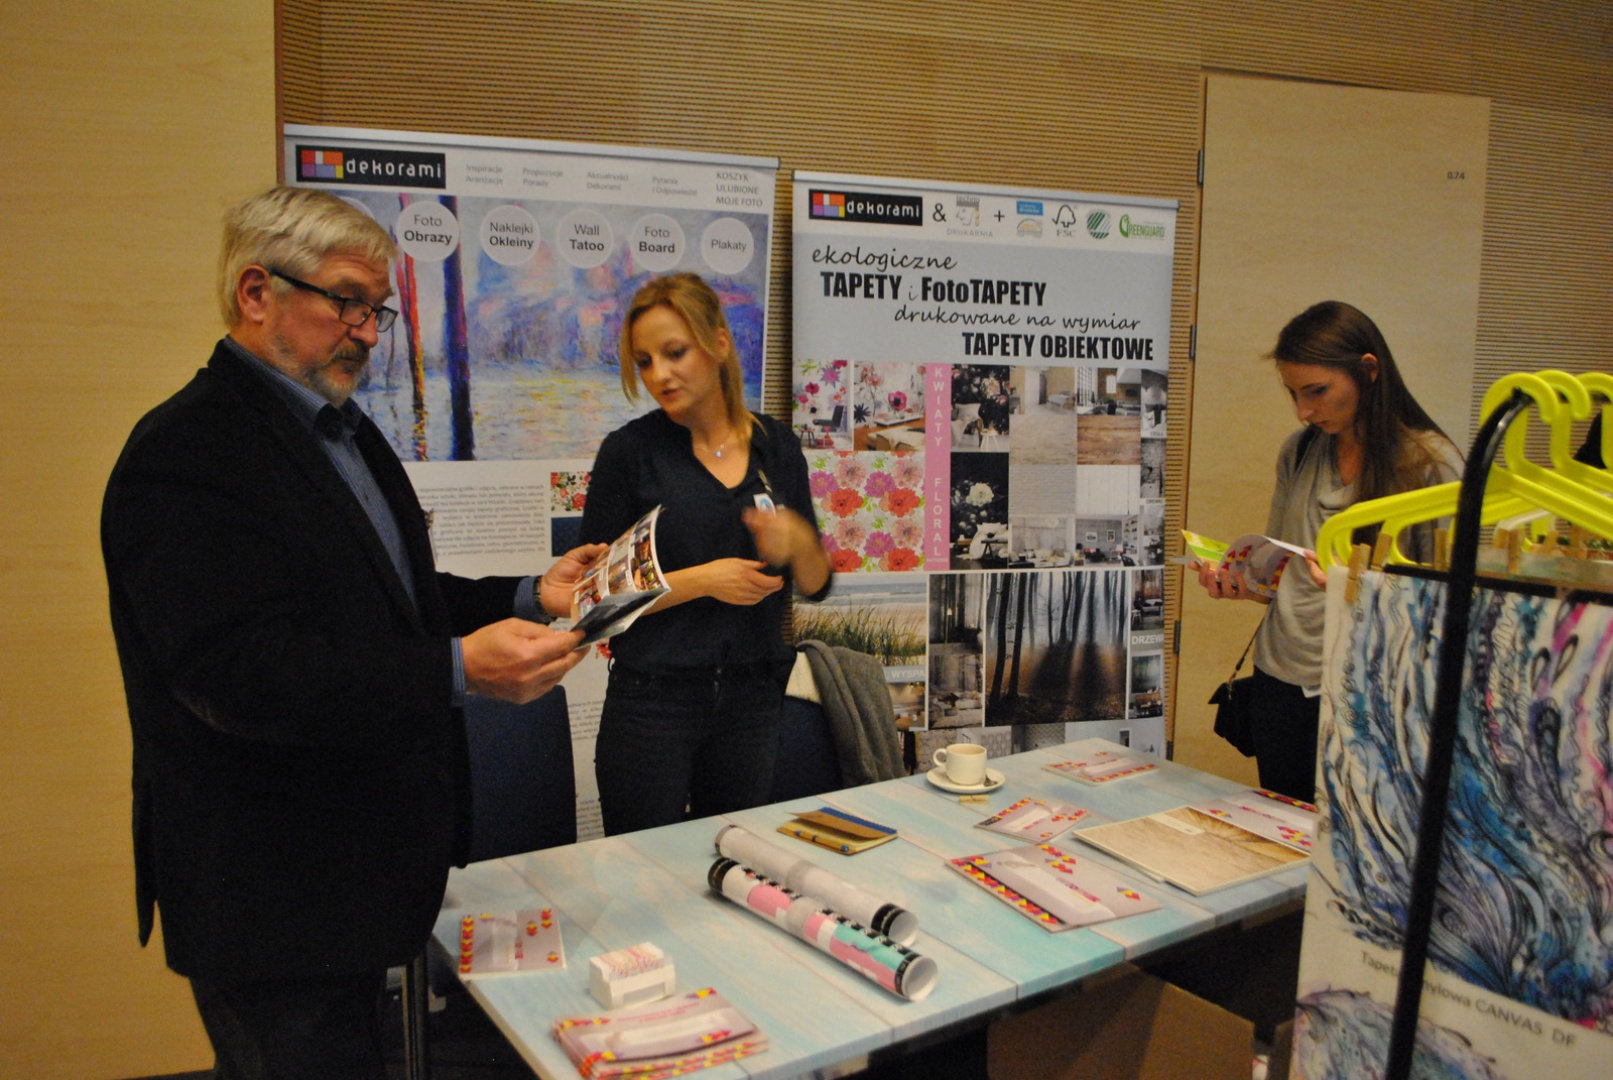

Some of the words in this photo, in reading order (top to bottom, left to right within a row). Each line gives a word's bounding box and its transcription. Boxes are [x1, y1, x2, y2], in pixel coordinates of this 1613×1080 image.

[346, 157, 443, 179] dekorami
[716, 171, 749, 182] KOSZYK
[716, 184, 759, 195] ULUBIONE
[716, 196, 739, 206] MOJE
[741, 198, 763, 208] FOTO
[846, 201, 921, 219] dekorami
[932, 203, 947, 223] &
[414, 214, 443, 228] Foto
[489, 221, 534, 236] Naklejki
[574, 223, 600, 236] Wall
[644, 227, 670, 239] Foto
[946, 228, 994, 238] DRUKARNIA
[1056, 229, 1076, 237] FSC
[404, 230, 452, 246] Obrazy
[489, 235, 534, 251] Okleiny
[569, 238, 605, 252] Tatoo
[638, 240, 676, 254] Board
[711, 239, 747, 253] Plakaty
[812, 245, 957, 272] ekologiczne
[821, 271, 902, 300] TAPETY
[908, 285, 918, 301] i
[921, 277, 1047, 306] FotoTAPETY
[894, 304, 1020, 326] drukowane
[1026, 313, 1056, 327] na
[1062, 314, 1141, 334] wymiar
[962, 332, 1036, 357] TAPETY
[1040, 335, 1154, 361] OBIEKTOWE
[933, 366, 944, 447] KWIATY
[933, 477, 943, 556] FLORAL
[1475, 999, 1542, 1036] CANVAS
